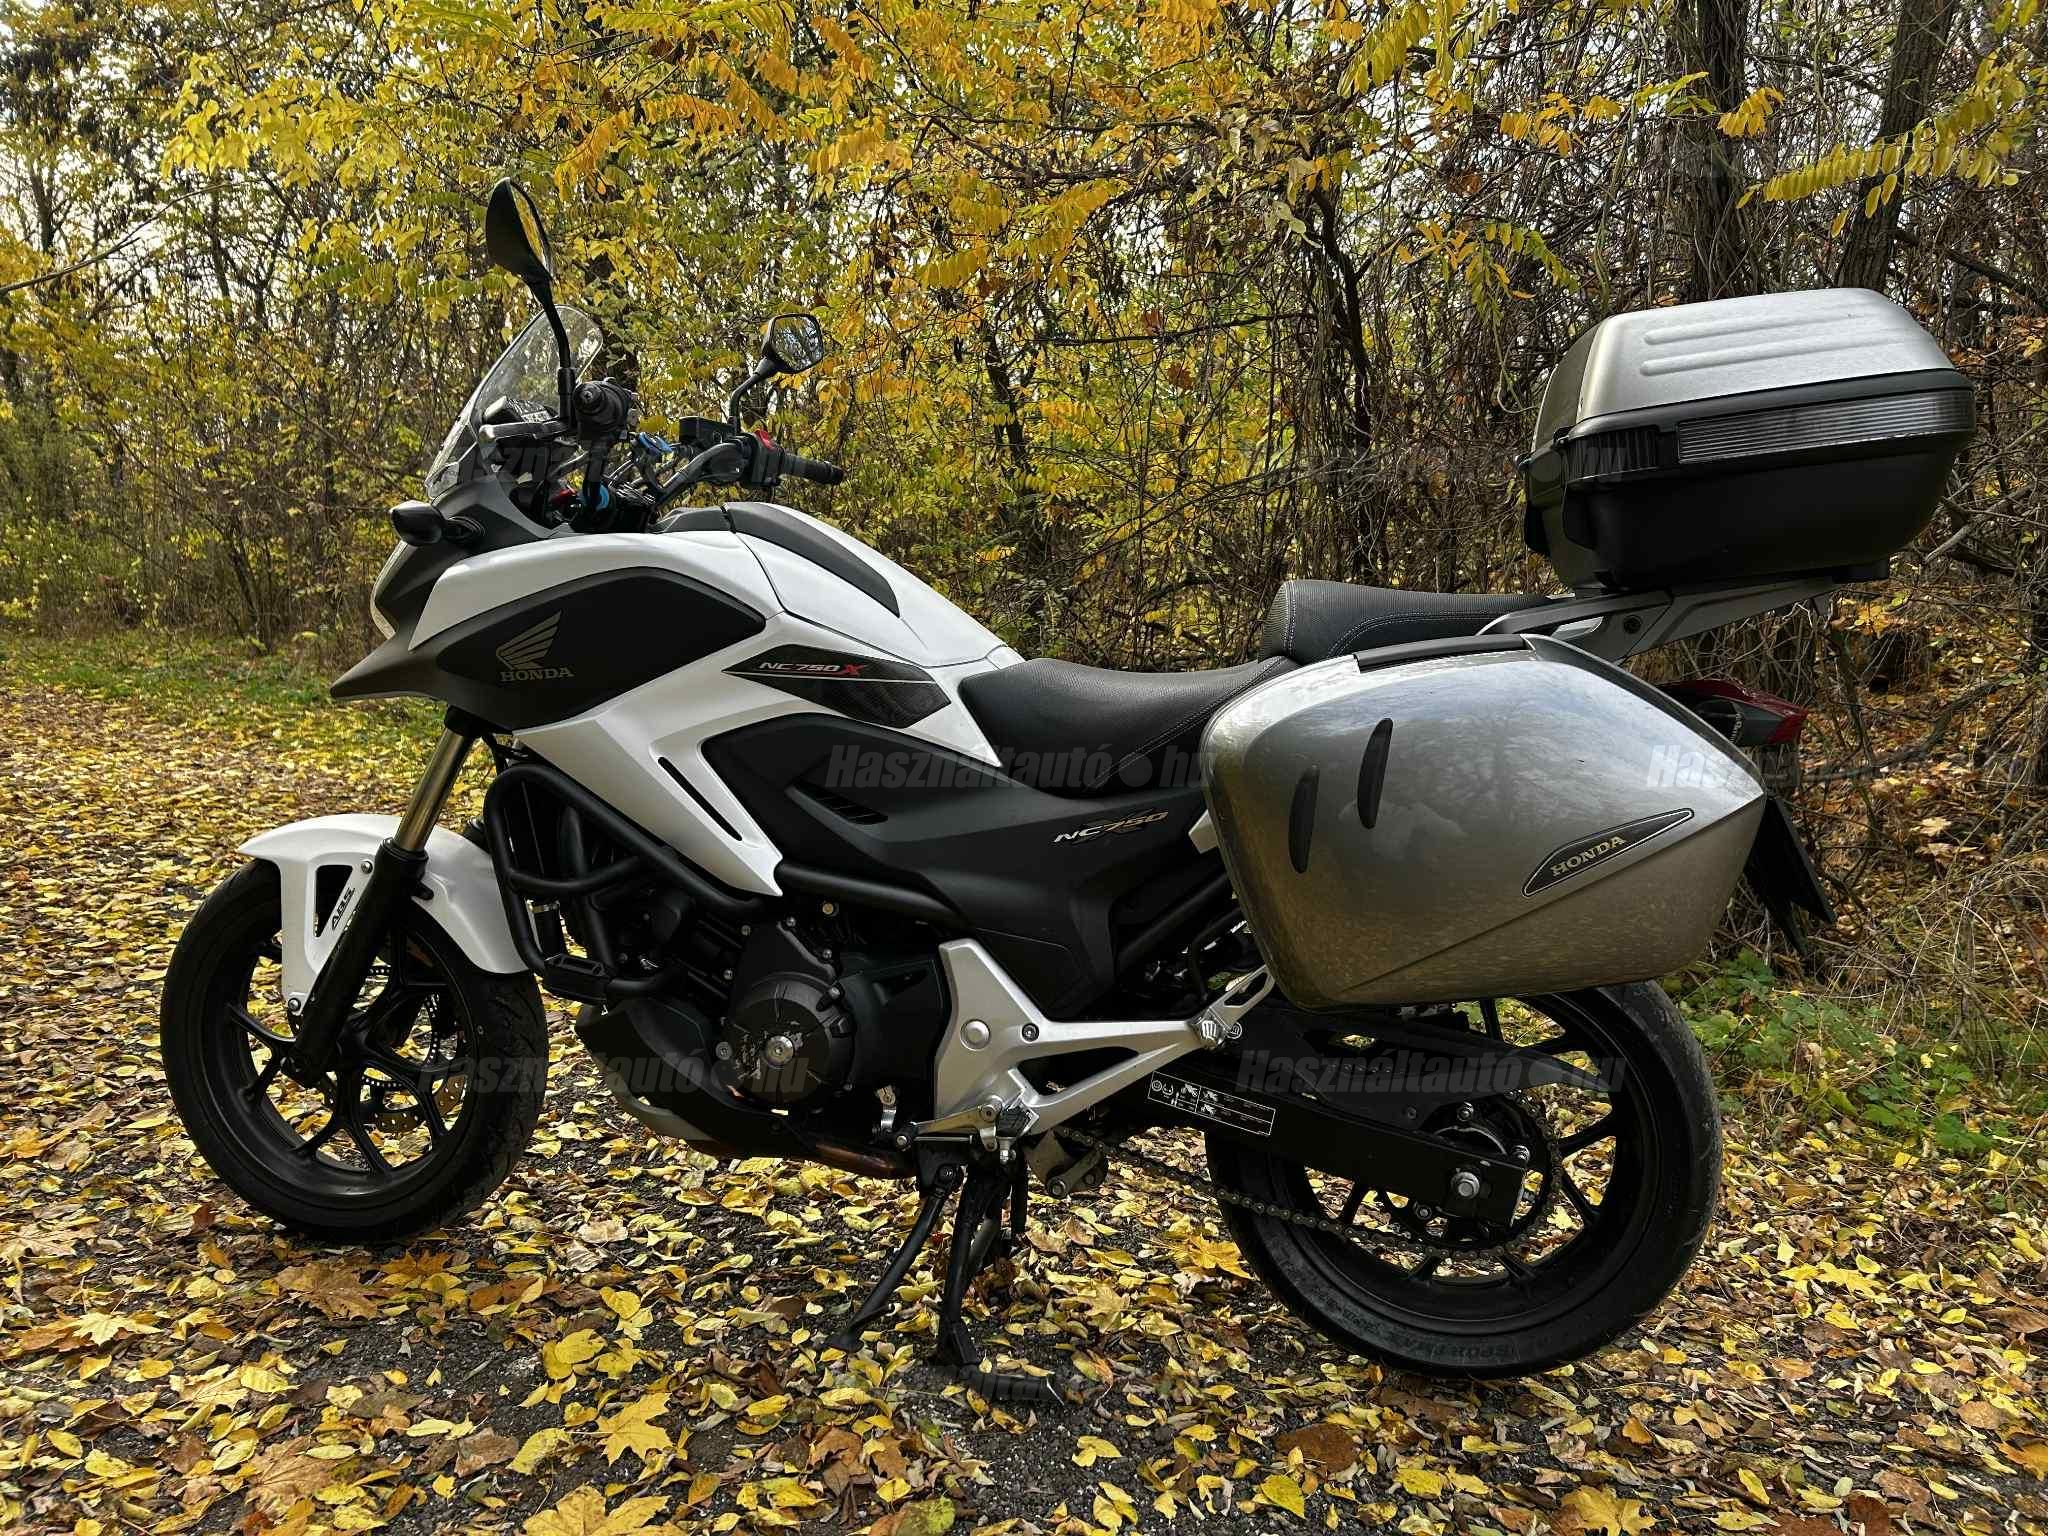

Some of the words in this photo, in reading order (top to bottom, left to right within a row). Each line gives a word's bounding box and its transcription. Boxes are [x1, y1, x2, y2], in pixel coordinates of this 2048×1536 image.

[499, 664, 576, 682] HONDA
[758, 662, 865, 678] NC750X
[1550, 835, 1627, 876] HONDA
[331, 887, 356, 931] ABS
